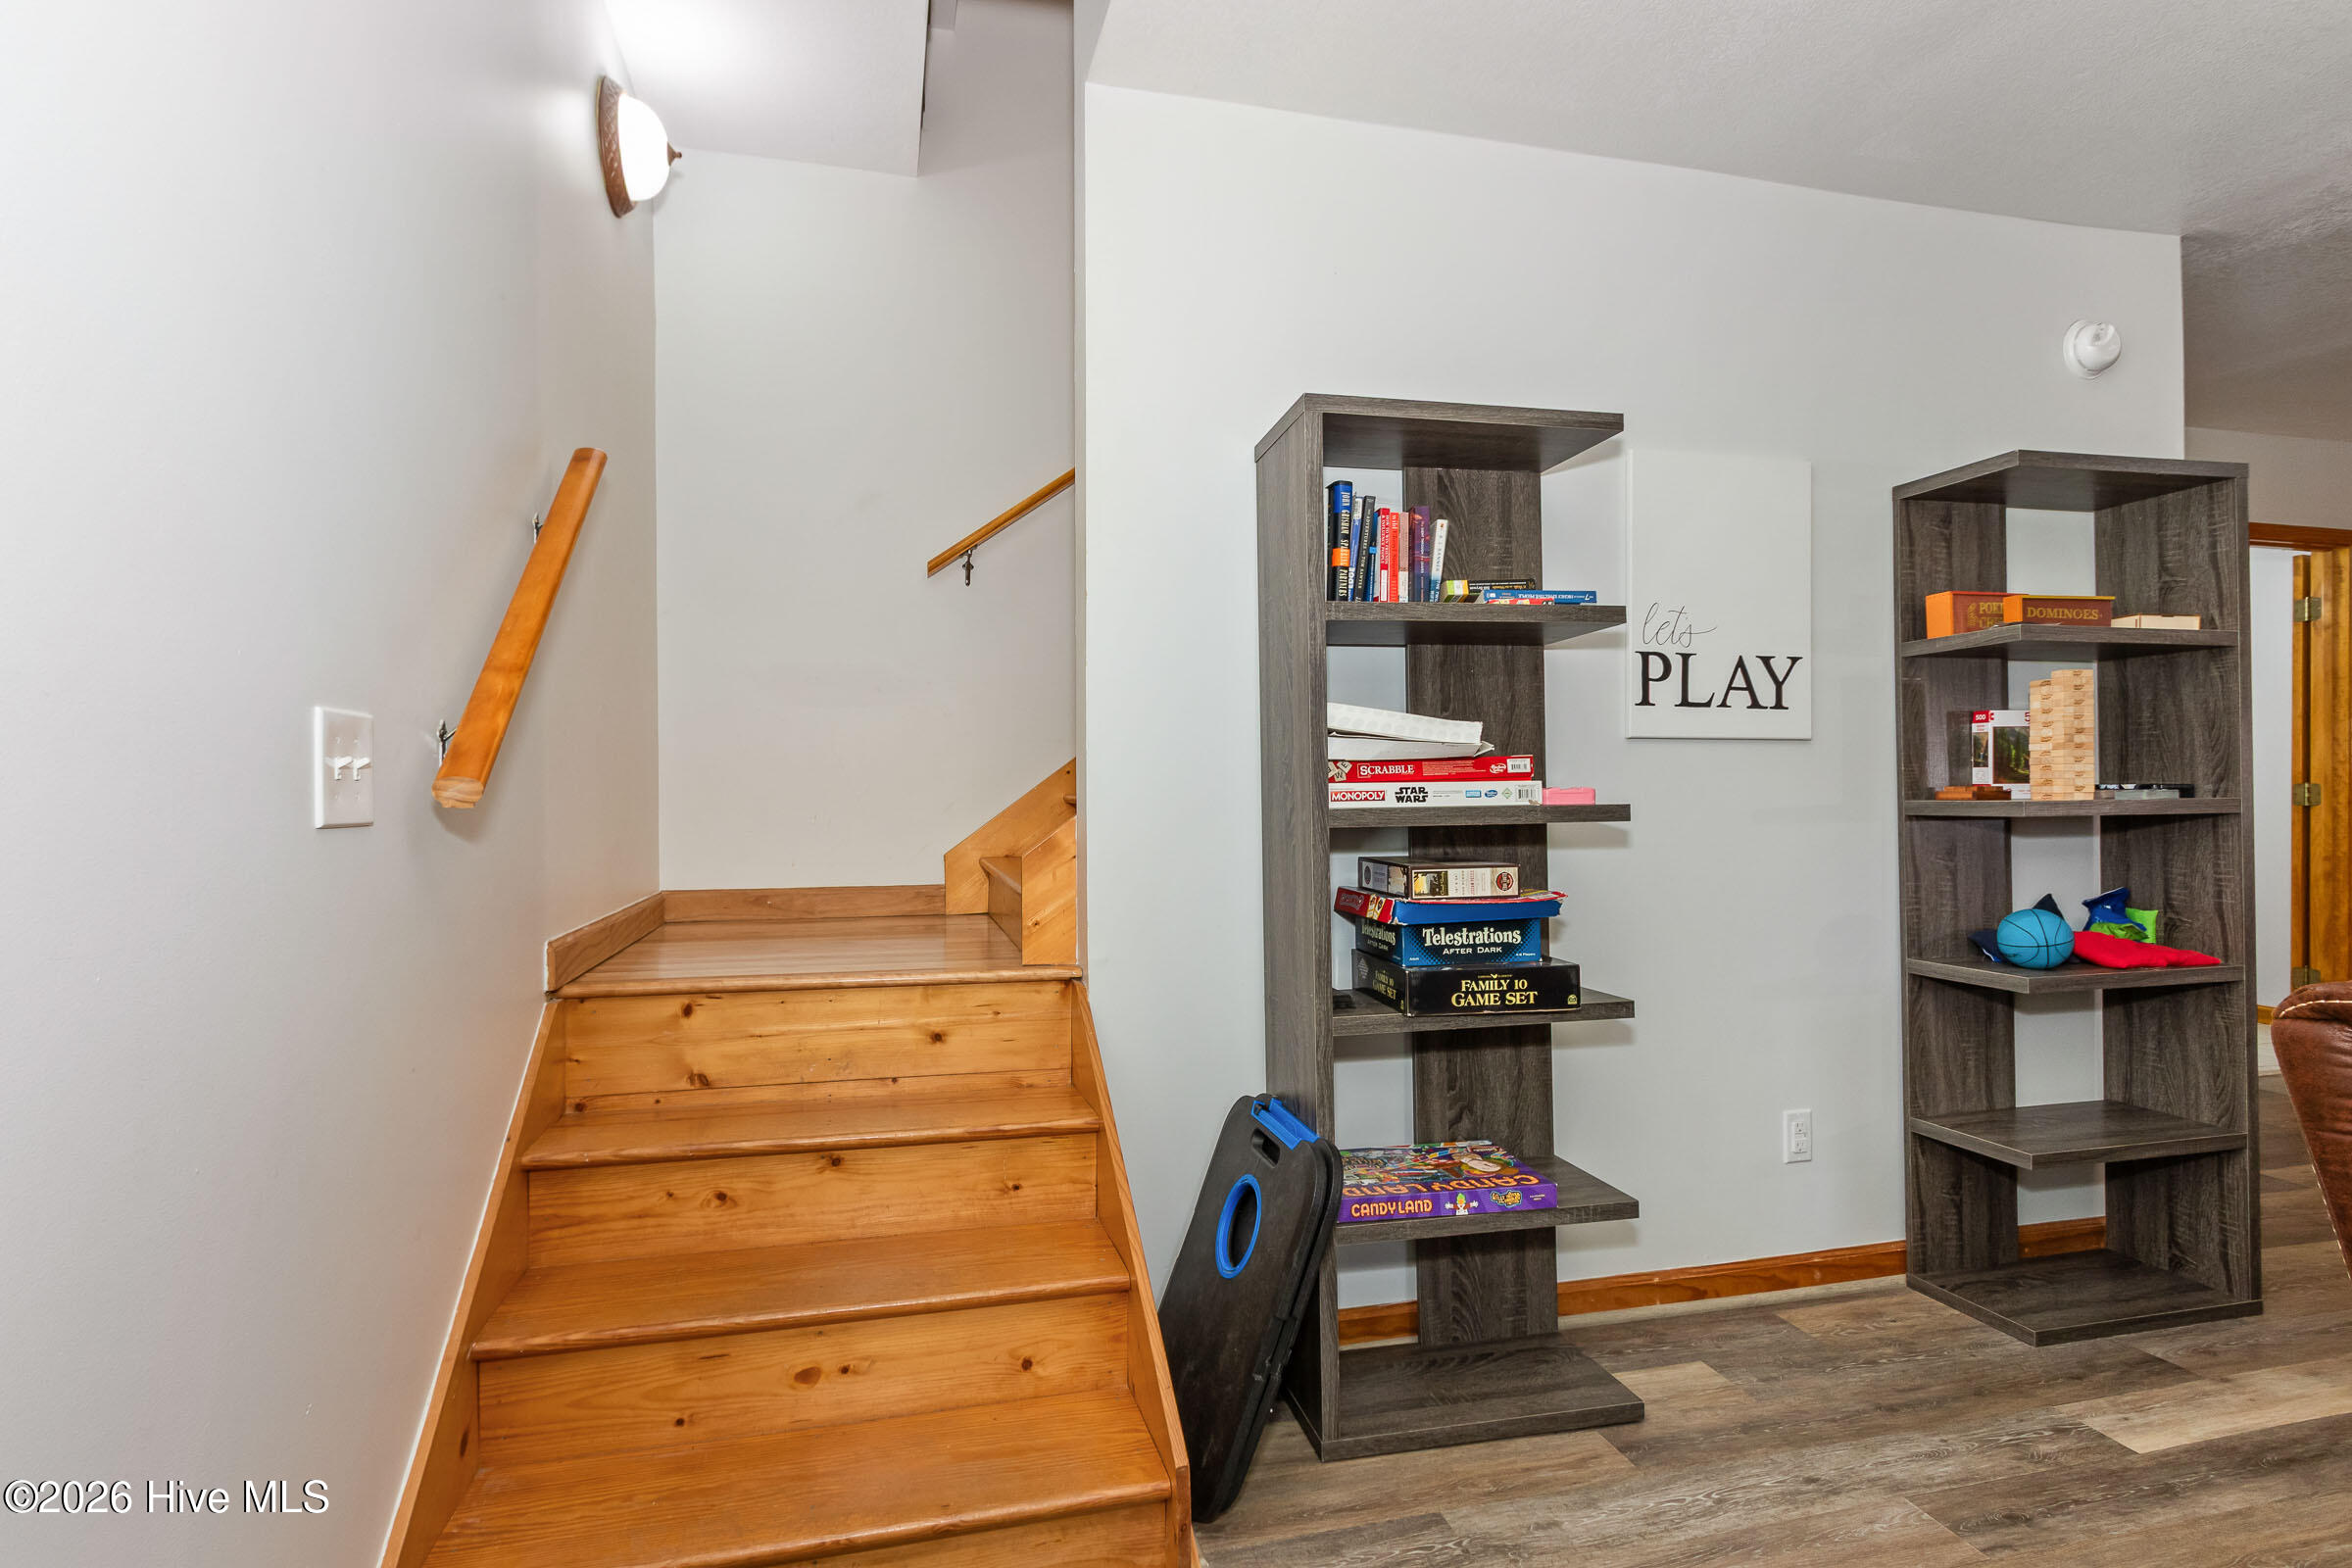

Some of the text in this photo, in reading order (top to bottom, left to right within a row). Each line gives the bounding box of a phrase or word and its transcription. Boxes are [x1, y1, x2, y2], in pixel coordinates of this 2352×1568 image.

[1341, 492, 1350, 507] JOHN
[1340, 510, 1350, 535] GRISHAM
[2027, 607, 2099, 620] DOMINOES
[1635, 651, 1803, 710] PLAY
[1359, 764, 1415, 776] SCRABBLE
[1331, 791, 1385, 801] MONOPOLY
[1395, 795, 1429, 804] WARS
[1422, 926, 1522, 947] Telestrations
[1461, 979, 1528, 992] FAMILY 10
[1451, 991, 1539, 1007] GAME SET
[1350, 1199, 1433, 1217] CANDY LAND
